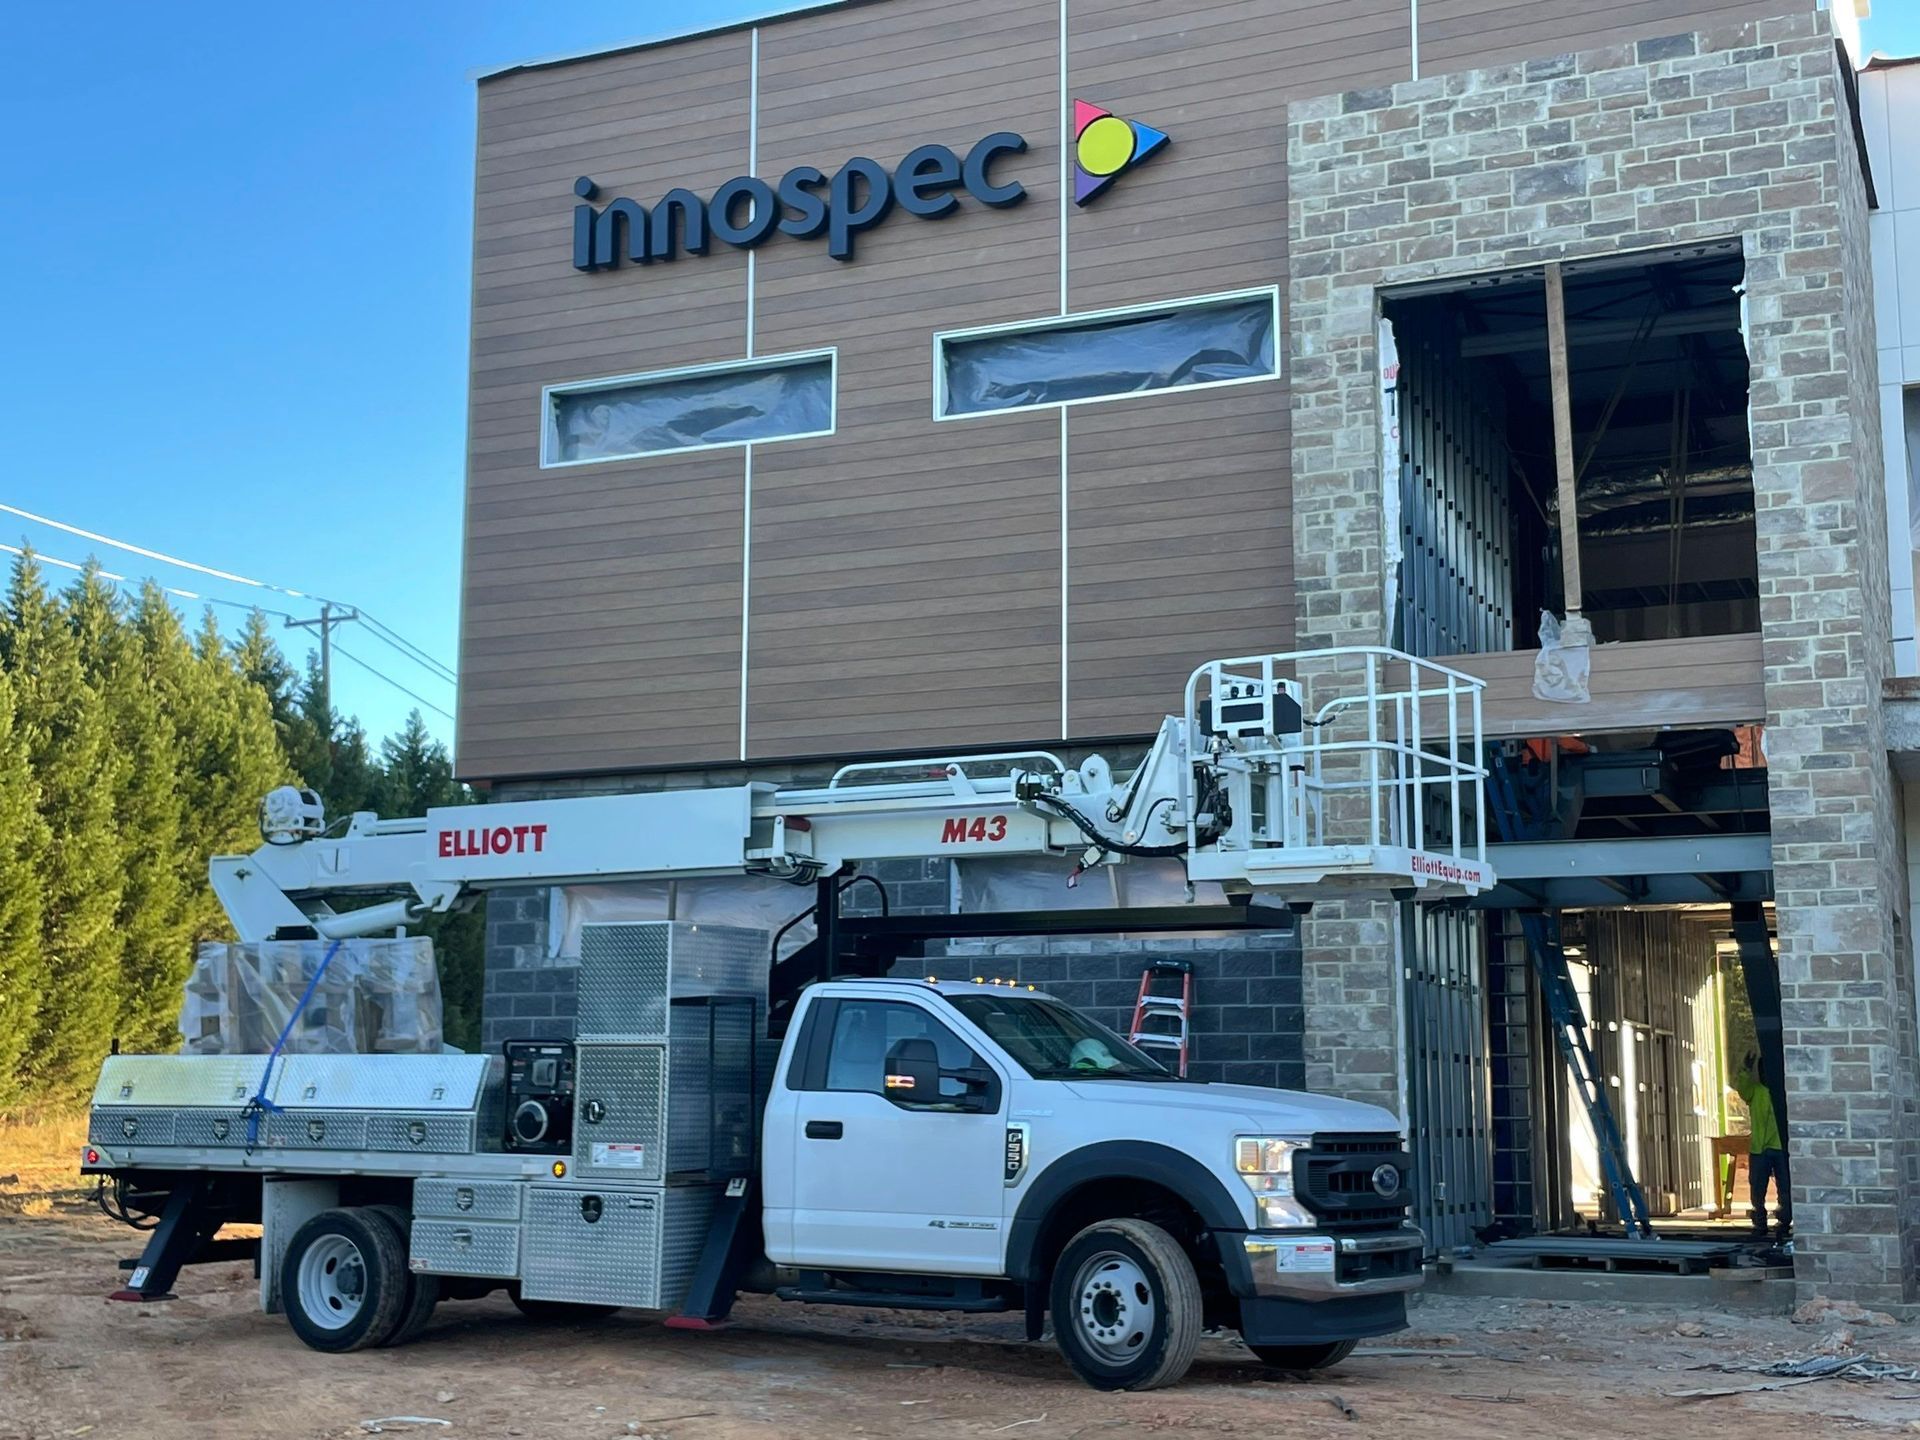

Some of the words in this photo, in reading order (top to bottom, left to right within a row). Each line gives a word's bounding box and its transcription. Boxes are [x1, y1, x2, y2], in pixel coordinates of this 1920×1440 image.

[573, 131, 1028, 272] innospec
[438, 824, 548, 858] ELLIOTT
[941, 815, 1008, 843] M43
[1411, 855, 1481, 883] ElliottEquip.com
